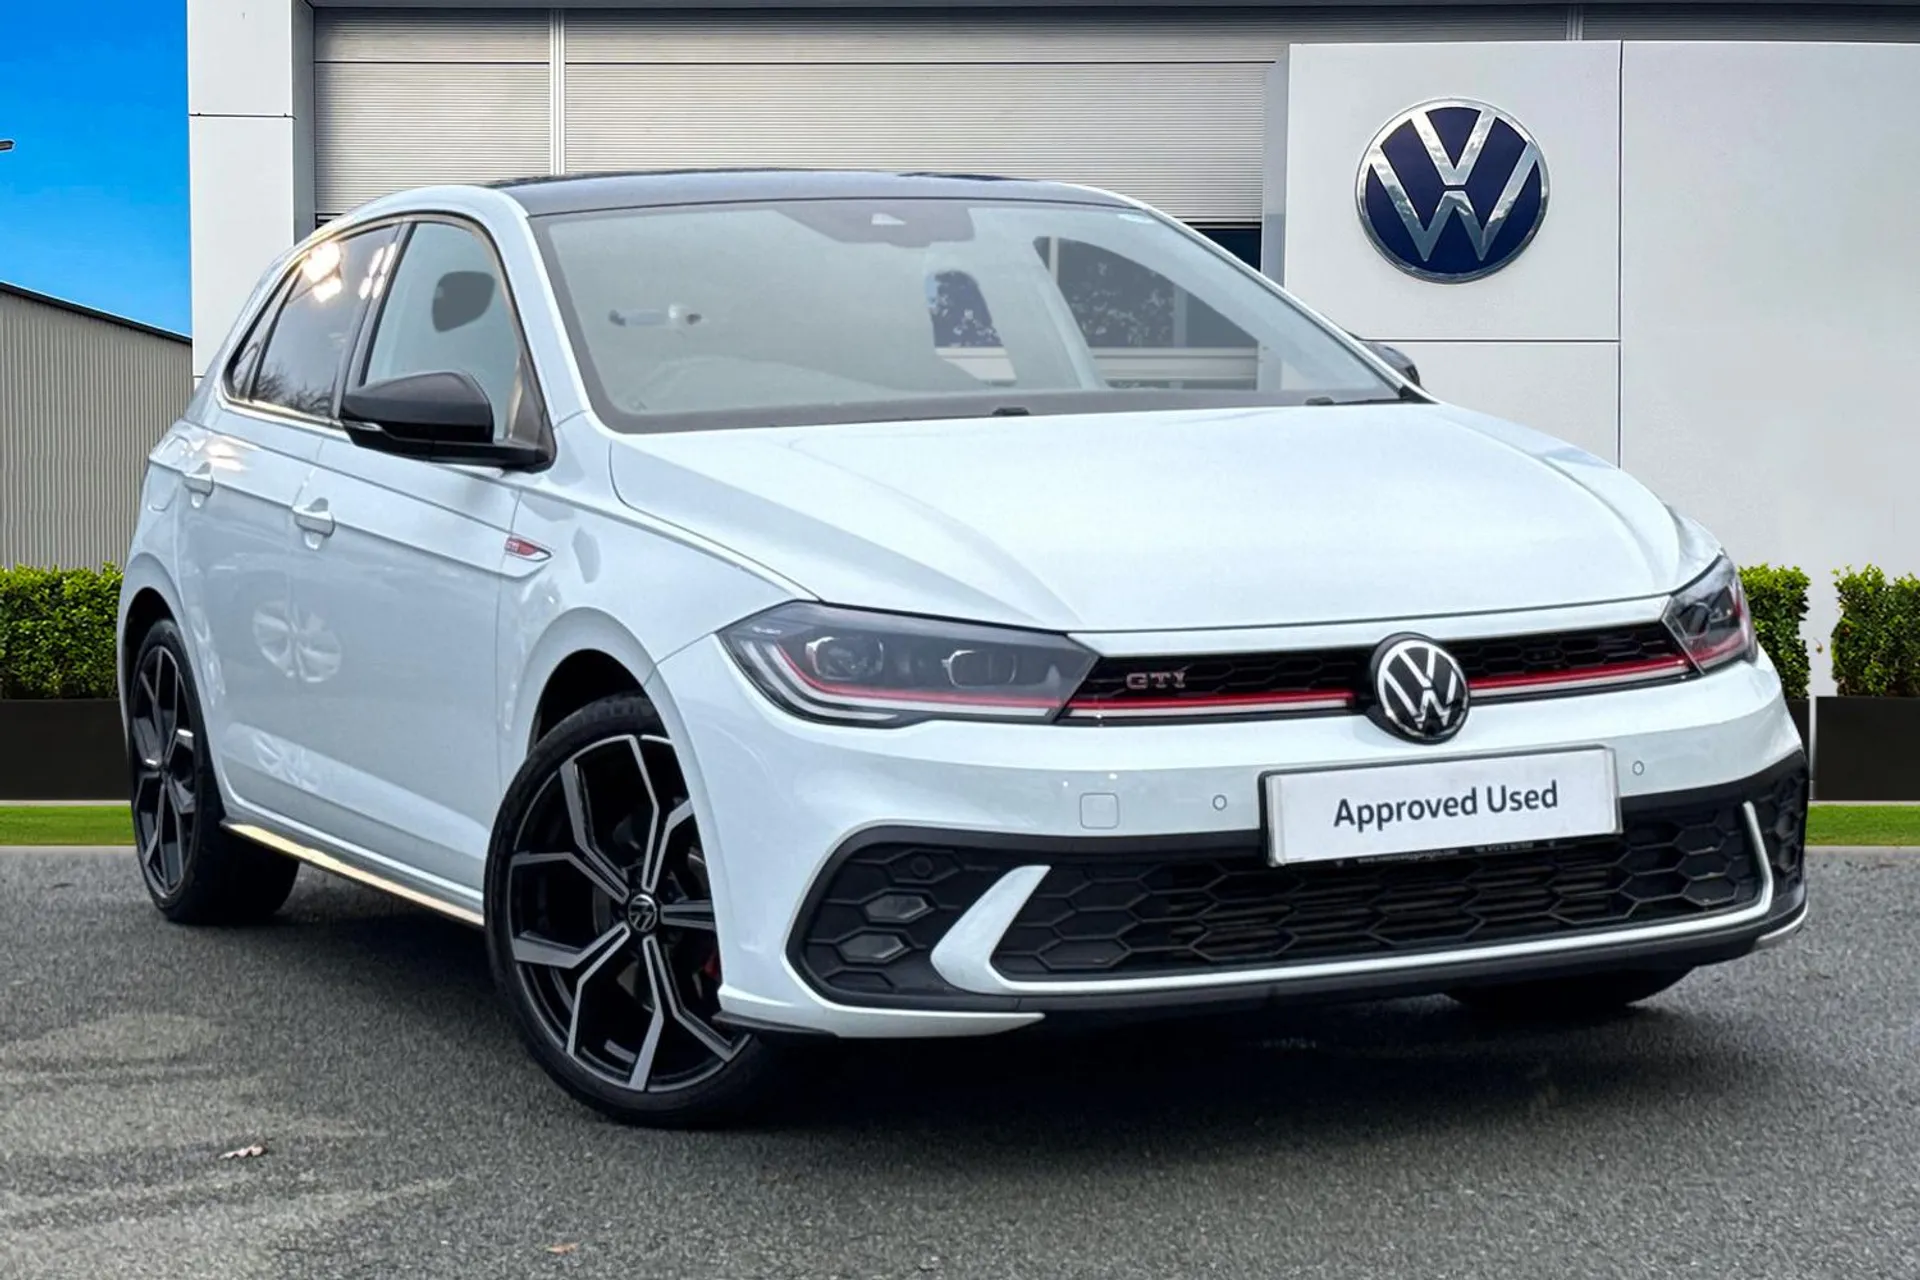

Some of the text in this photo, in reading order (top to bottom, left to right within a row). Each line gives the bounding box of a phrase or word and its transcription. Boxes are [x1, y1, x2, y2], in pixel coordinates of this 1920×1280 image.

[1359, 102, 1545, 268] VW
[1126, 672, 1186, 690] GTI
[1381, 642, 1461, 733] VW
[1334, 779, 1558, 833] Approved Used
